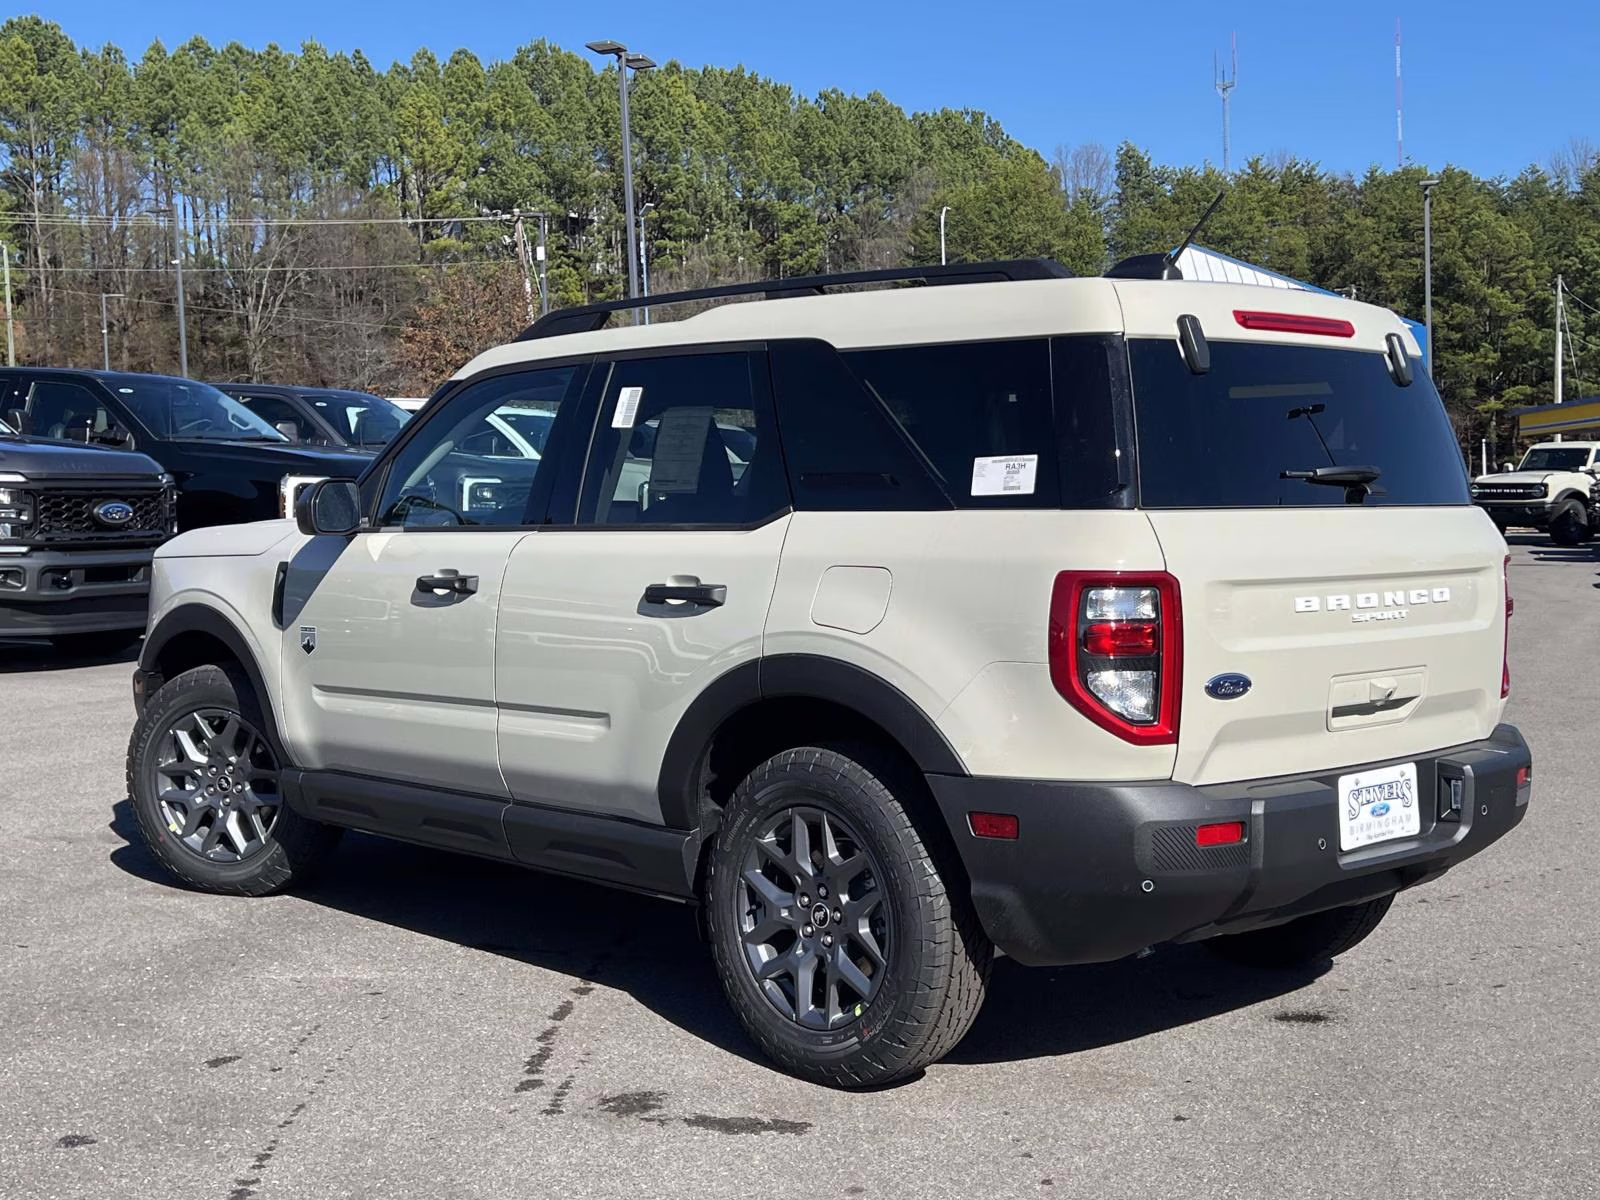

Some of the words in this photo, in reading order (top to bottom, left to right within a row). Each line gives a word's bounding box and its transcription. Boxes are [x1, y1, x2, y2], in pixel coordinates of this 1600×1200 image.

[1295, 588, 1450, 613] BRONCO
[1352, 609, 1409, 623] SPORT
[1348, 779, 1413, 821] STIVERS
[1350, 814, 1412, 836] BIRMINGHAM
